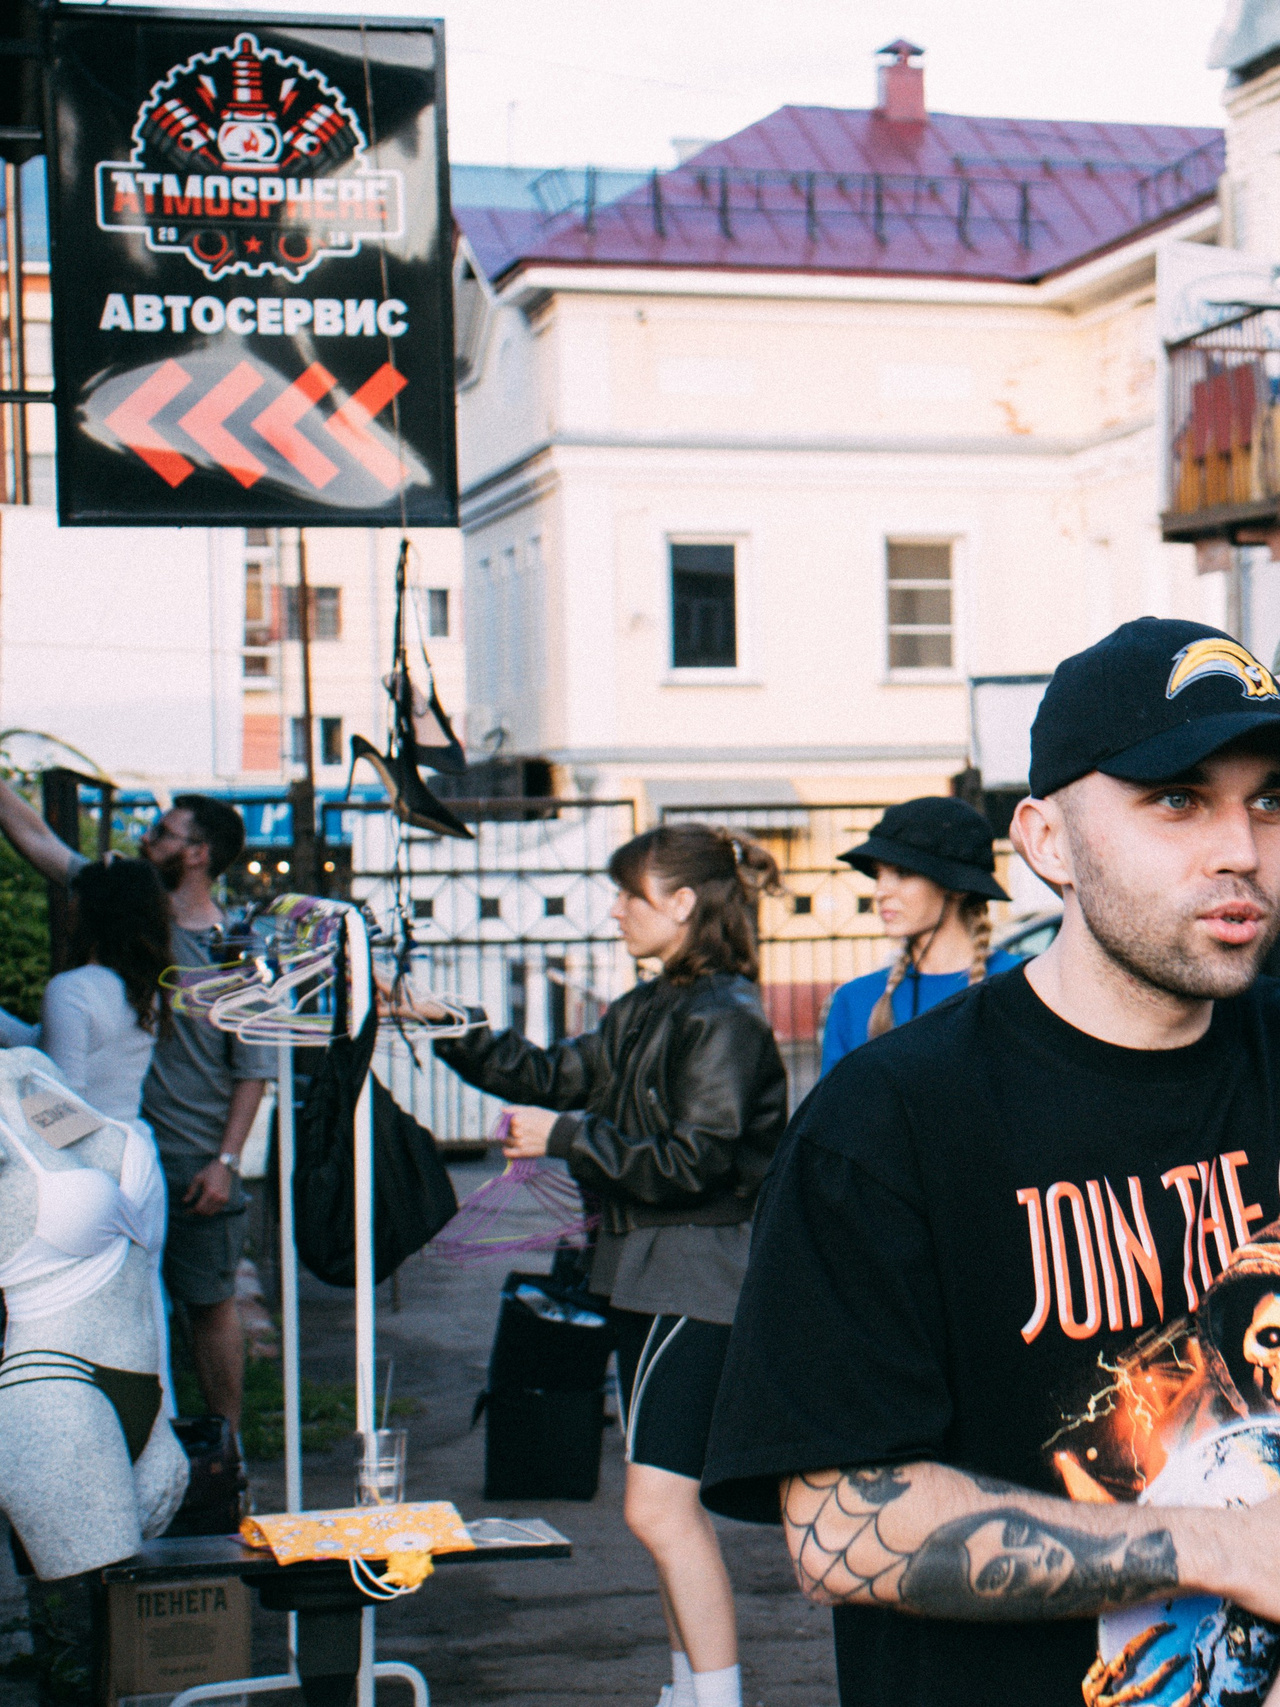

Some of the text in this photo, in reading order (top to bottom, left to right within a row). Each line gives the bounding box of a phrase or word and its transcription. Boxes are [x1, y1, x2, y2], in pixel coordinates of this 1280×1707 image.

[110, 171, 389, 220] ATMOSPHERE
[99, 293, 410, 338] АВТОСЕРВИС
[1016, 1175, 1164, 1346] JOIN
[1160, 1150, 1264, 1314] THE
[136, 1586, 228, 1619] ПЕНЕГА
